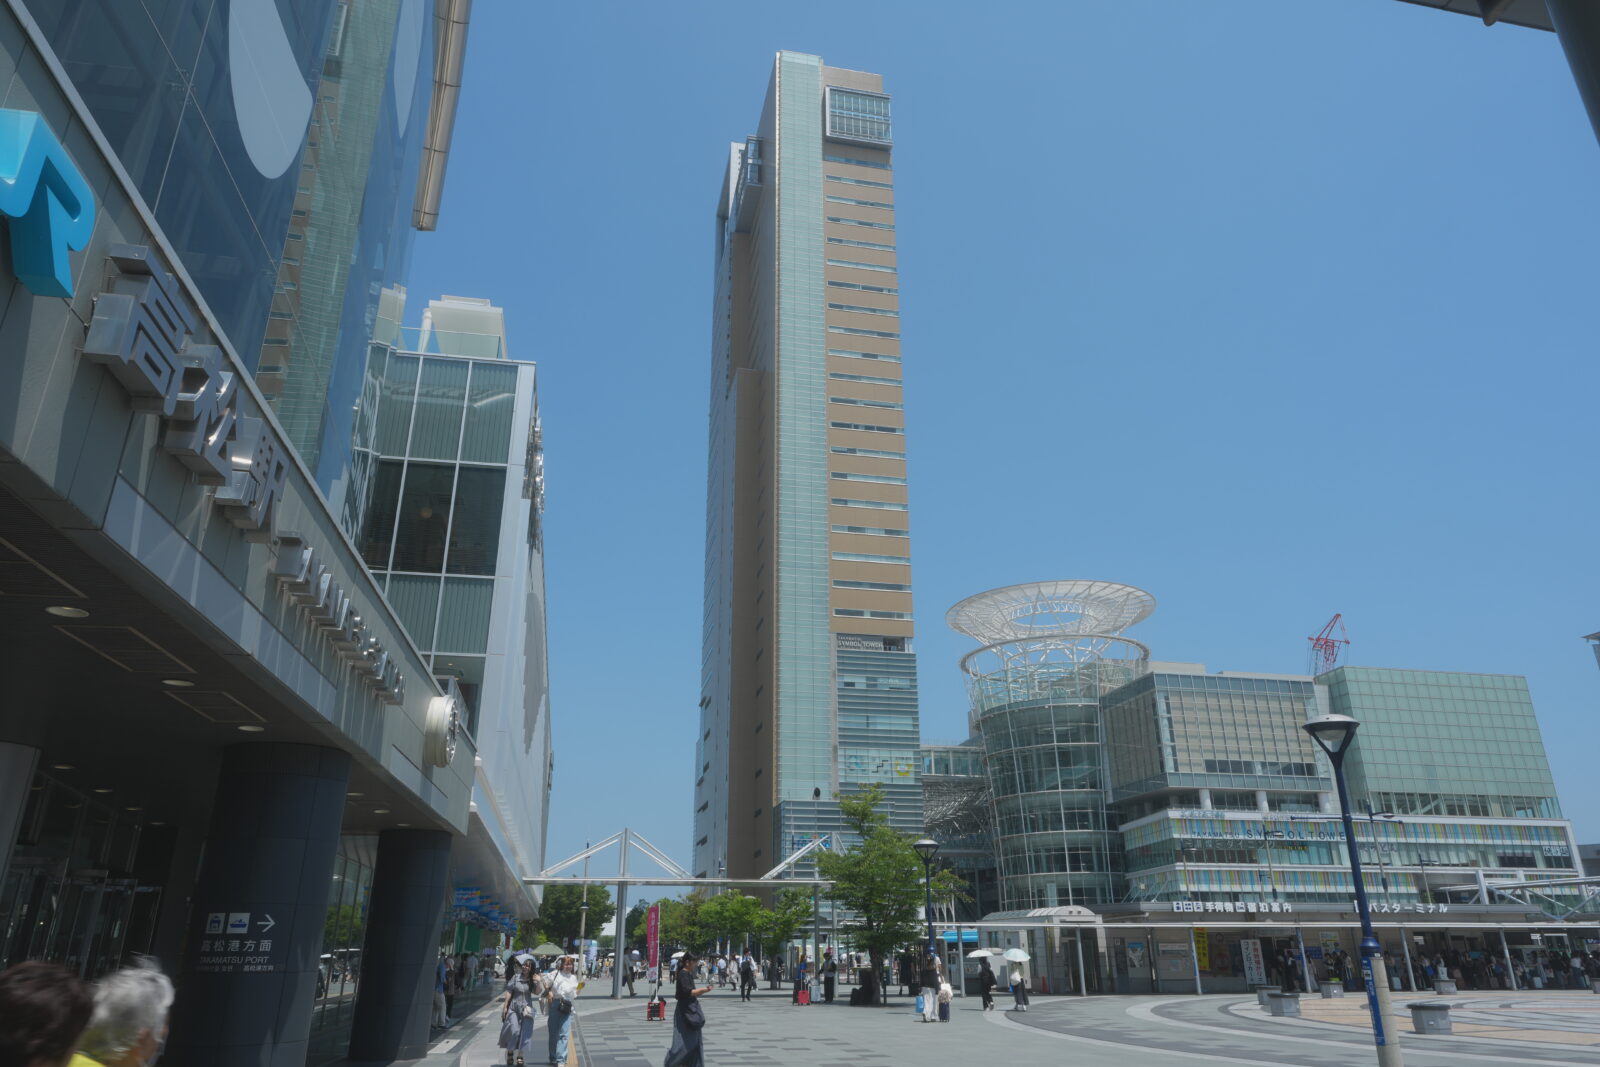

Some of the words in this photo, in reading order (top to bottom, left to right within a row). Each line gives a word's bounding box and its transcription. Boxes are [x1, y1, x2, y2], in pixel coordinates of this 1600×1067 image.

[85, 243, 291, 526] 高松駅
[1205, 902, 1234, 912] 手荷物
[1247, 902, 1292, 913] 宿泊案内
[1368, 903, 1448, 913] バスターミナル
[200, 939, 273, 952] 高松港方面
[200, 956, 244, 964] TAKAMATSU
[244, 956, 270, 964] PORT
